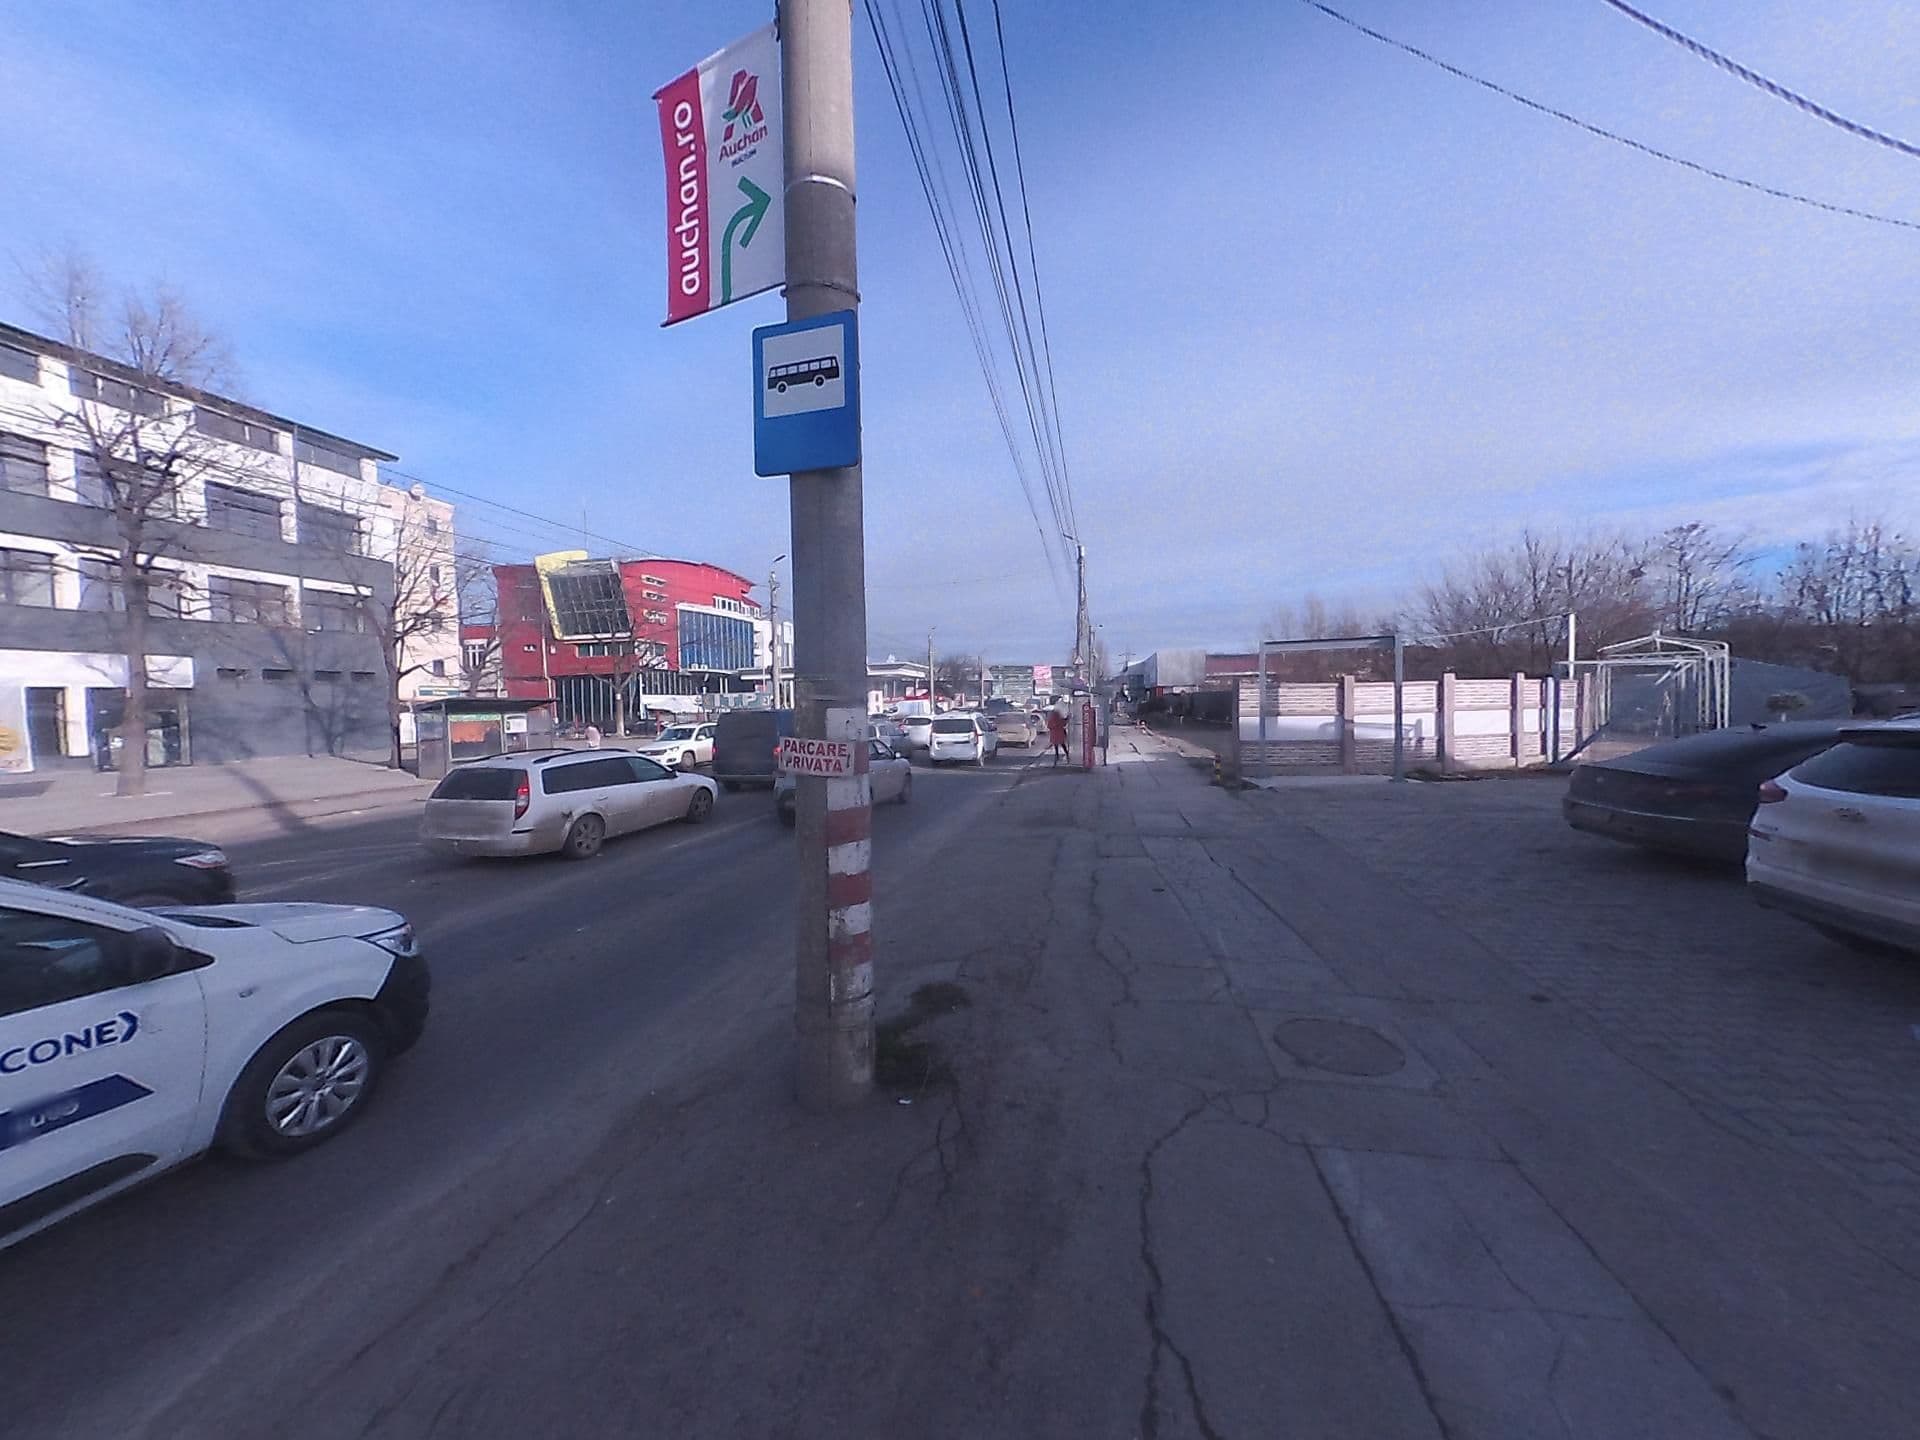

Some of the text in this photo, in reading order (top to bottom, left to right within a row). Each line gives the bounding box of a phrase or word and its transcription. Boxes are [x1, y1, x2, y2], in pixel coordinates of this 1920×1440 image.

[719, 125, 768, 162] Auchan
[674, 101, 700, 296] auchan.ro
[784, 739, 848, 757] PARCARE
